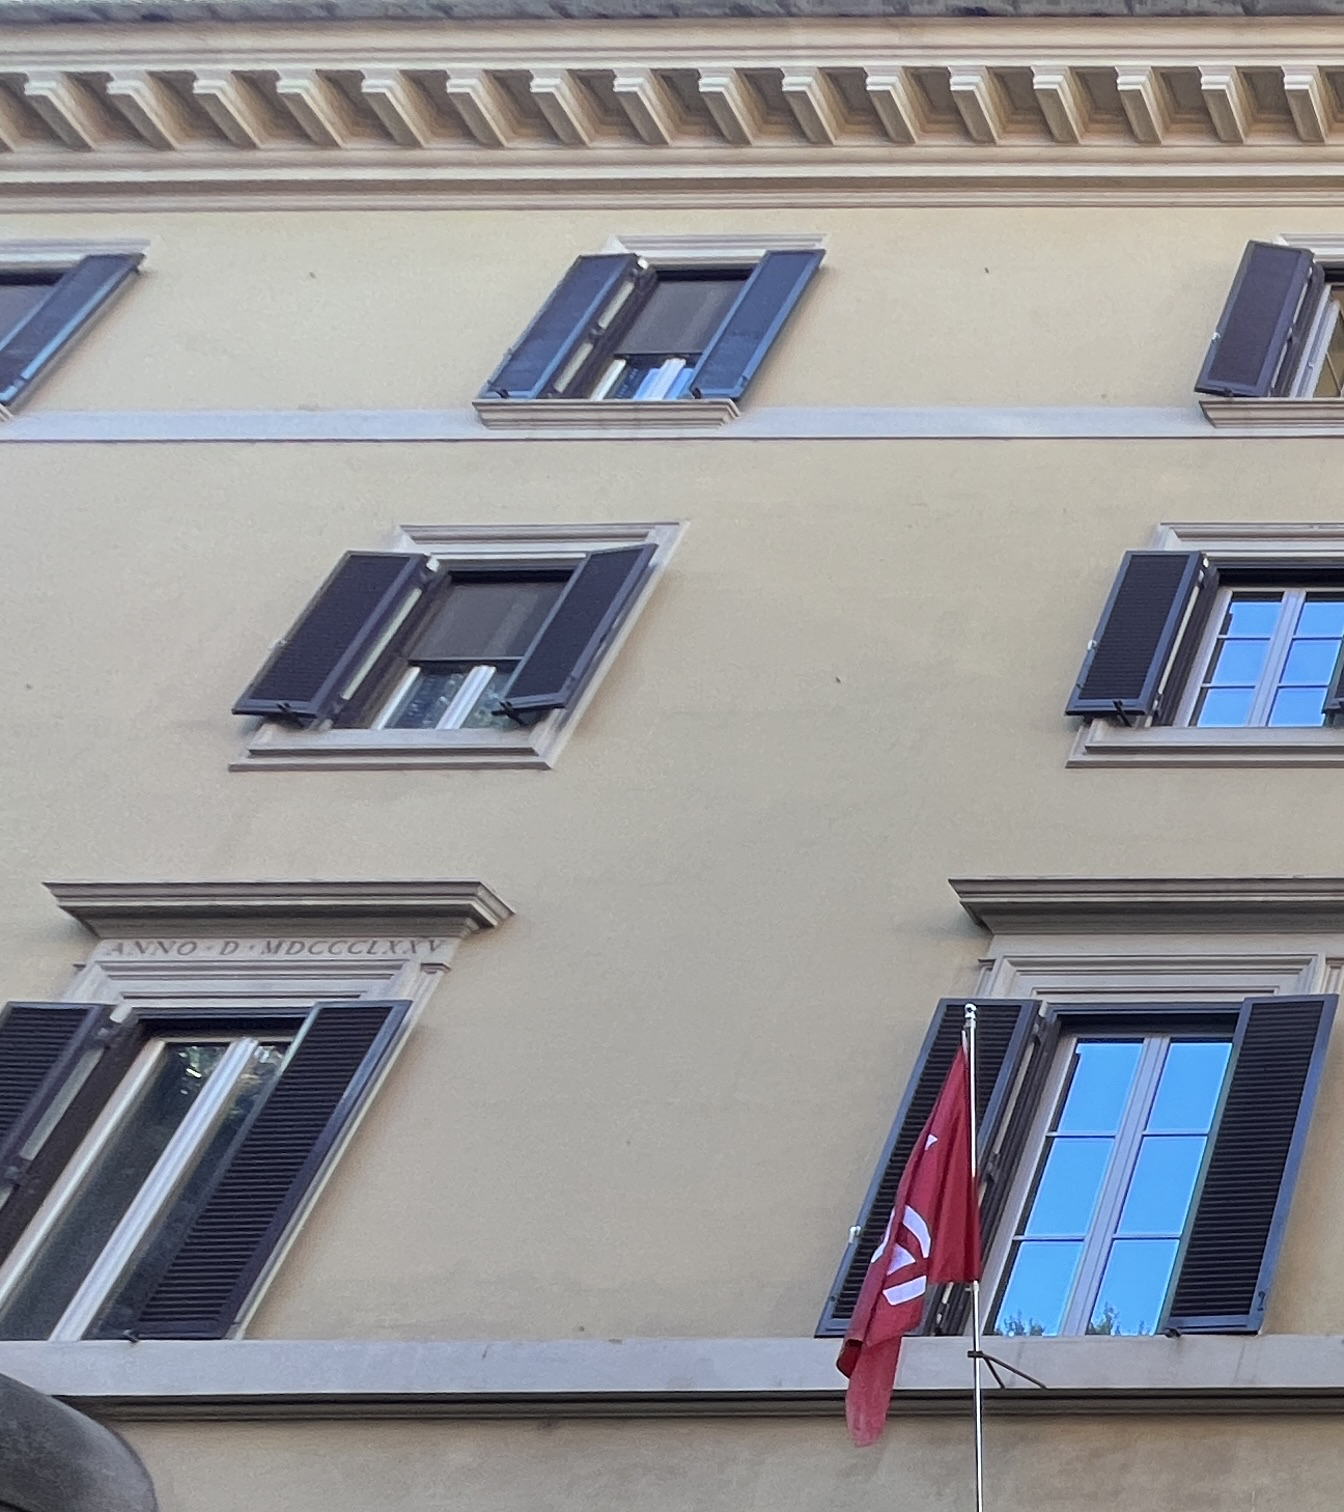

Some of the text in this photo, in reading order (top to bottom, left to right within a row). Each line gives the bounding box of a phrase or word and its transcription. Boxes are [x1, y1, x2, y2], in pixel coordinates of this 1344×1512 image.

[106, 940, 444, 956] ANNO D MDCCCLXXV
